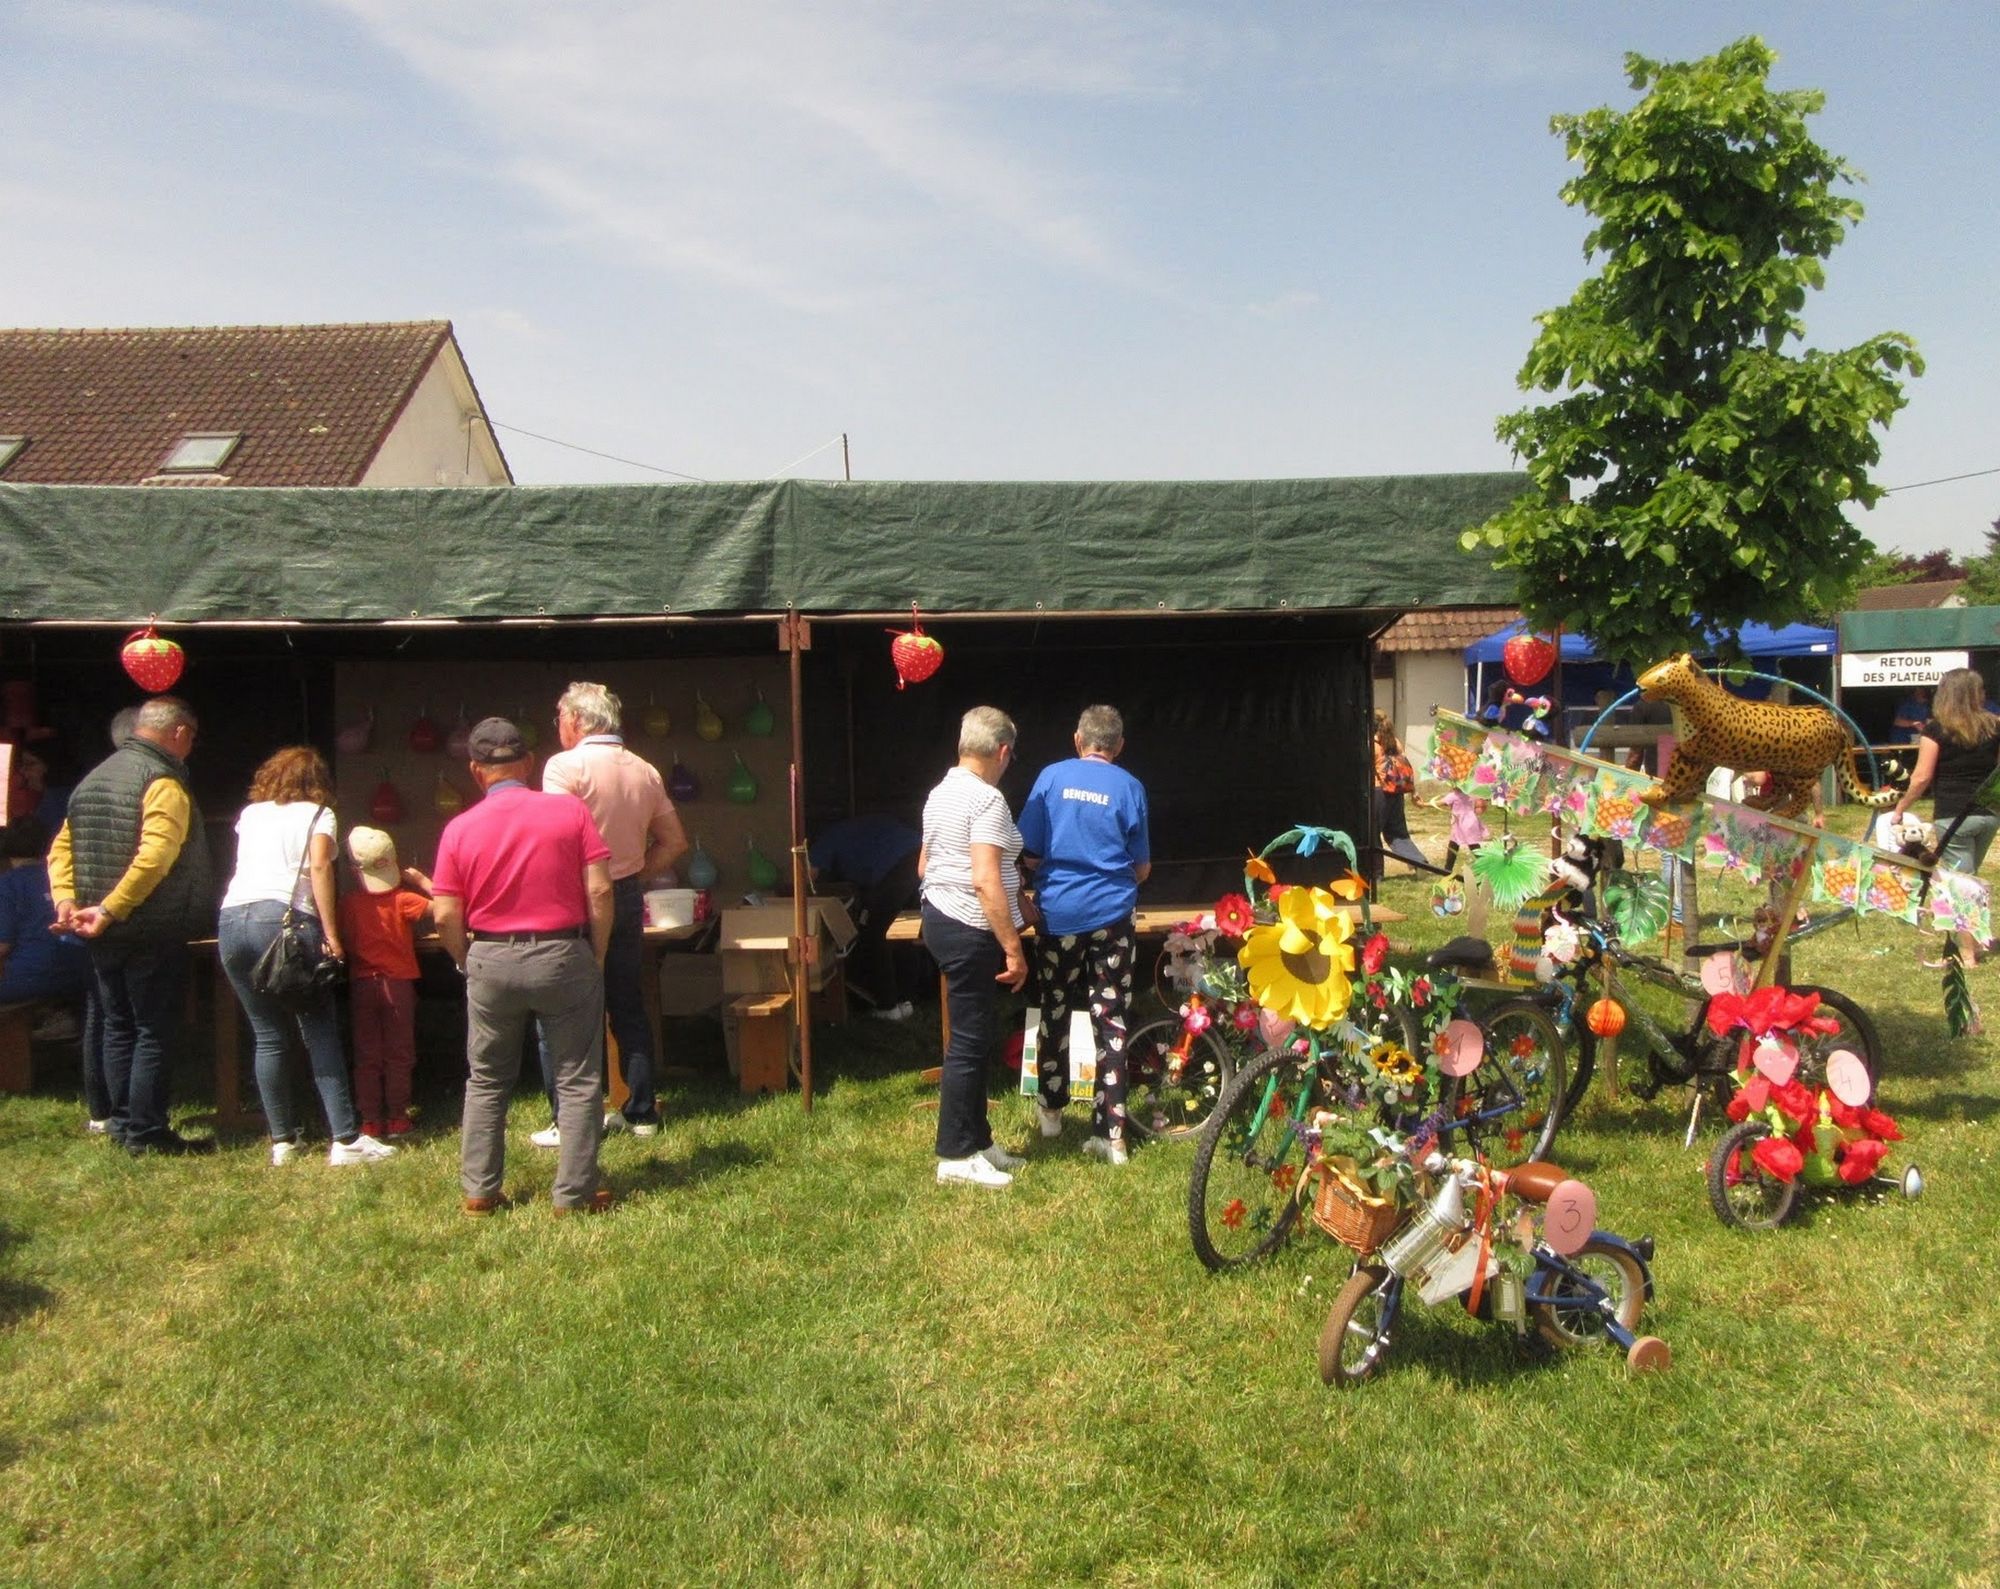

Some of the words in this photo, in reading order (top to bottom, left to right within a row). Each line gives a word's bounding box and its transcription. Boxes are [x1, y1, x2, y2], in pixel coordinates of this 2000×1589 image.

[1880, 656, 1932, 667] RETOUR
[1863, 672, 1885, 682] DES
[1062, 788, 1109, 806] BENEVOLE
[1718, 966, 1731, 988] 5
[1450, 1033, 1465, 1064] 1
[1560, 1199, 1582, 1233] 3
